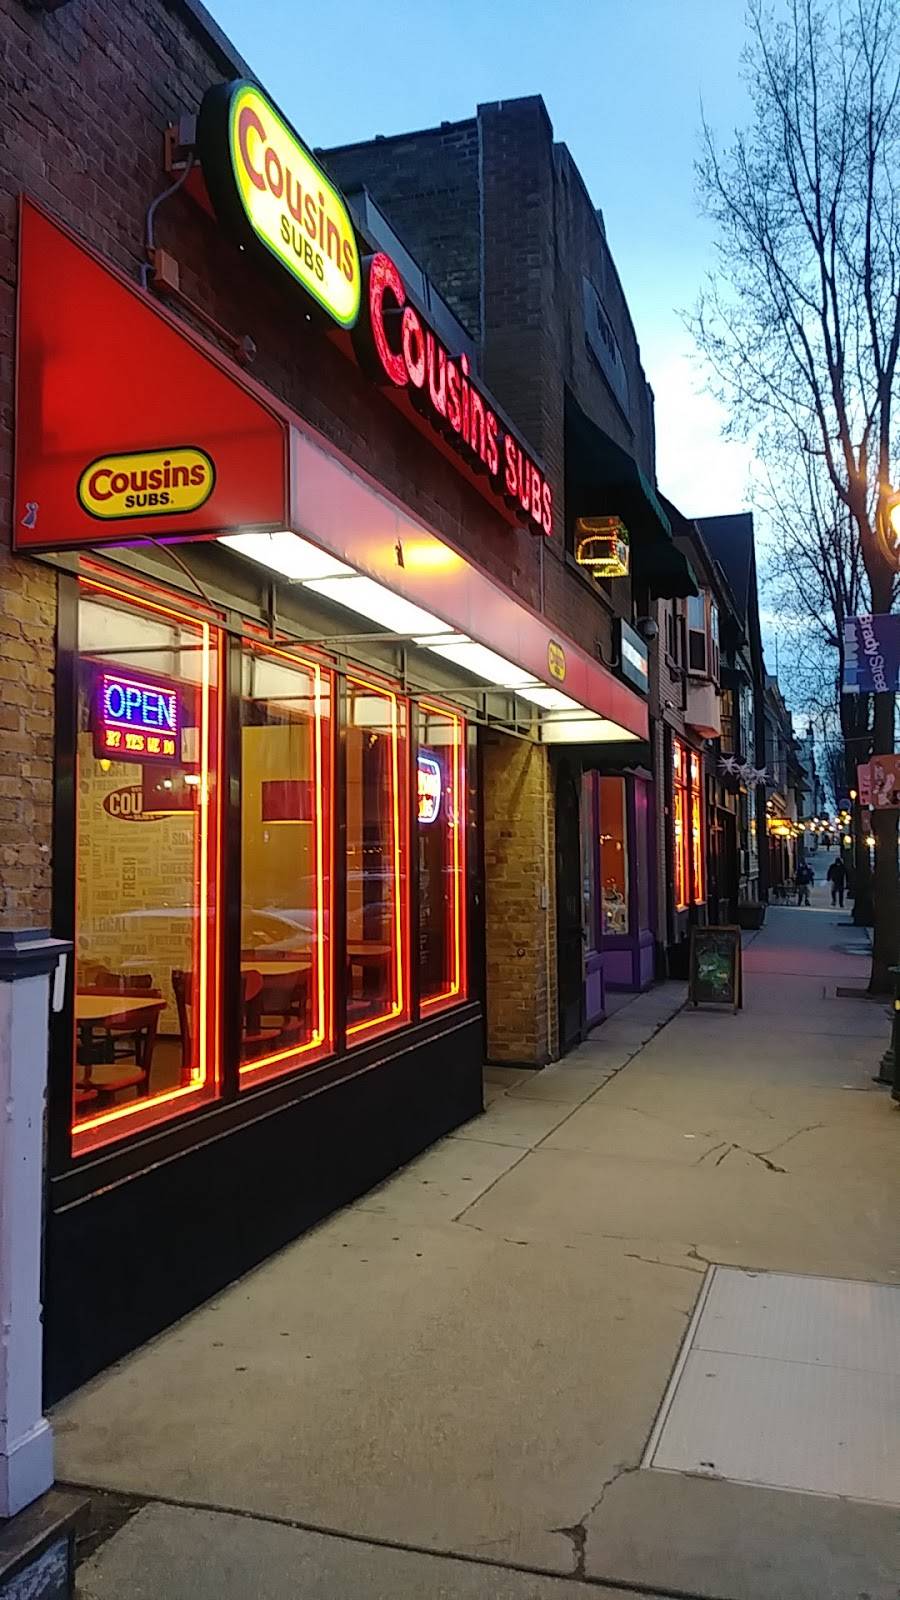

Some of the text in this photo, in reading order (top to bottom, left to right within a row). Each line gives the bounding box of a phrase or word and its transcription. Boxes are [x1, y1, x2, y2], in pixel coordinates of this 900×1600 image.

[239, 106, 354, 283] Cousins
[281, 214, 324, 282] SUBS
[370, 251, 552, 537] Cousins SUBS
[88, 460, 205, 501] Cousins
[859, 614, 889, 693] Brady Street
[107, 684, 176, 731] OPEN
[125, 733, 145, 751] YES
[122, 857, 136, 898] FRESH
